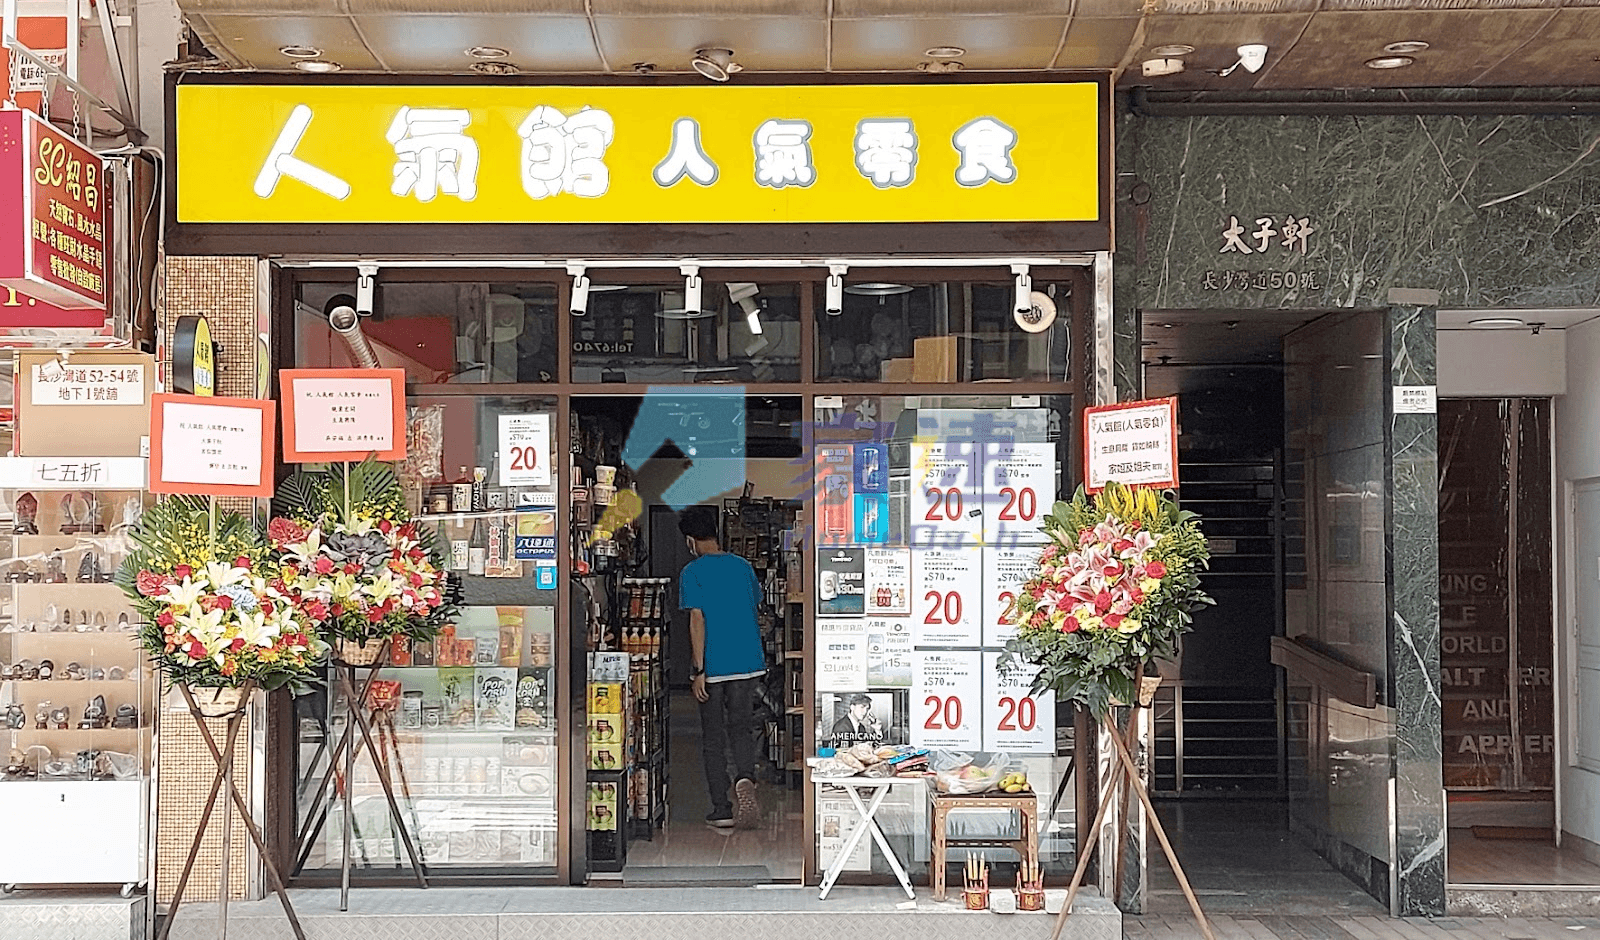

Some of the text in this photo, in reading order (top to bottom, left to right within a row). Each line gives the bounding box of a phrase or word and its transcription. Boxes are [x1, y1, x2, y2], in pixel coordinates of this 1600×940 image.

[253, 103, 1018, 202] 人氣館 人氣零食
[1219, 214, 1314, 256] 太子軒
[37, 462, 102, 482] 七五折
[510, 446, 537, 470] 20
[925, 487, 963, 521] 20
[998, 487, 1036, 521] 20
[924, 590, 962, 625] 20
[484, 681, 505, 689] POP
[924, 695, 962, 730] 20
[997, 697, 1036, 731] 20
[831, 732, 884, 741] AMERICANO
